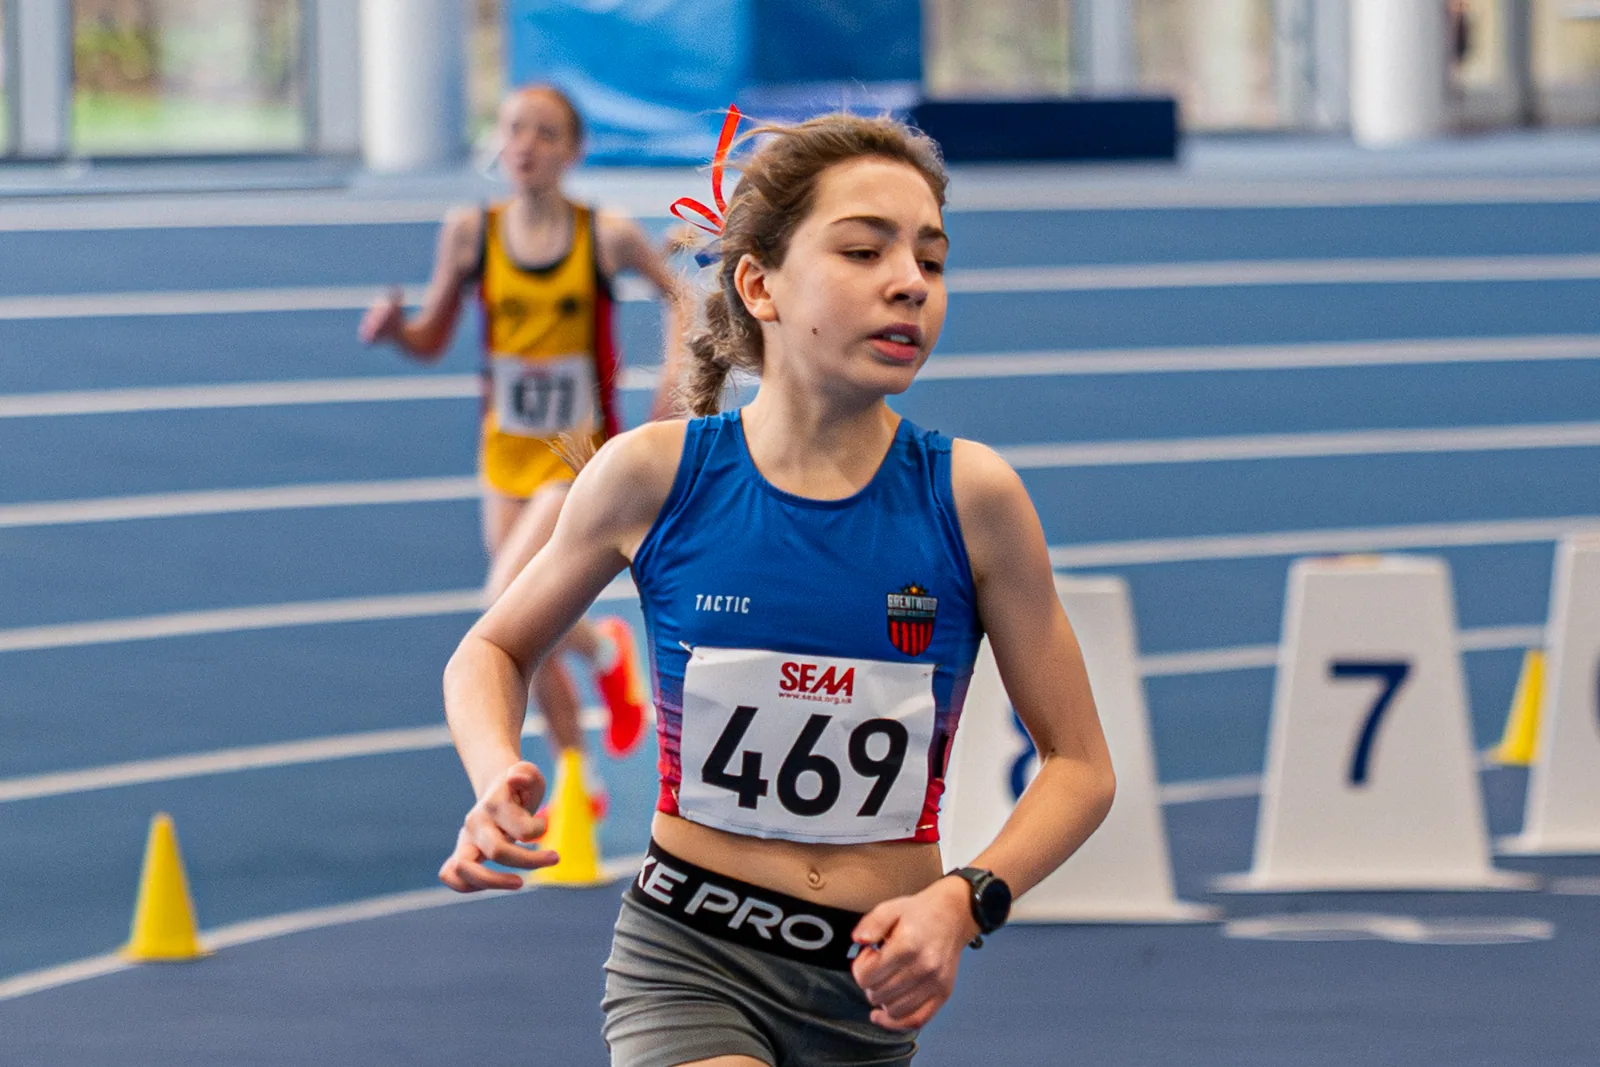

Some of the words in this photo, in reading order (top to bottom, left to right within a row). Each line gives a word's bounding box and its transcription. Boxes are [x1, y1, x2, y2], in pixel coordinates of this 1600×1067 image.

[694, 593, 751, 614] TACTIC
[779, 661, 855, 697] SEAA
[1329, 661, 1412, 787] 7
[701, 704, 909, 818] 469
[684, 881, 834, 951] PRO
